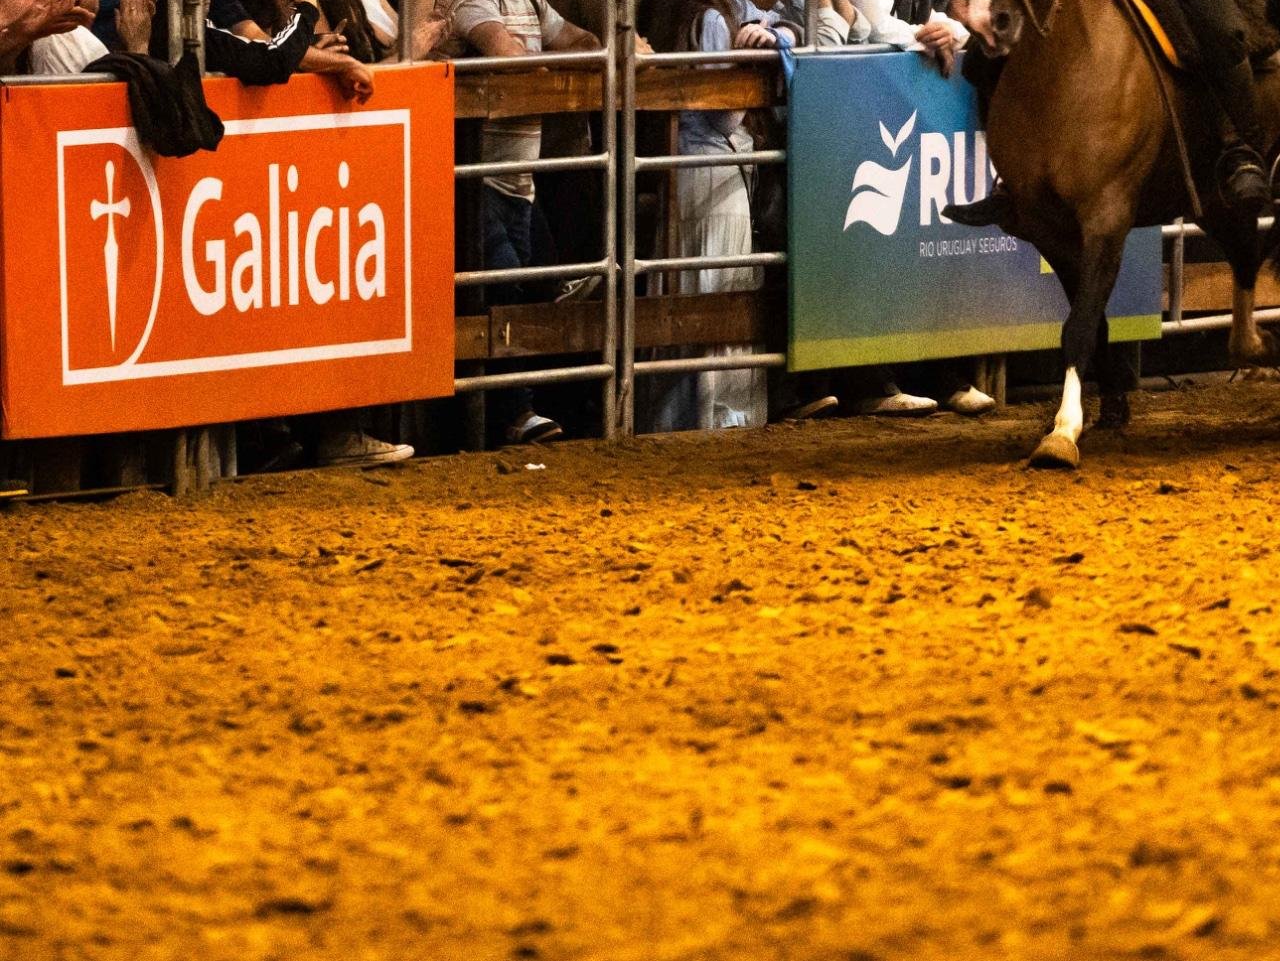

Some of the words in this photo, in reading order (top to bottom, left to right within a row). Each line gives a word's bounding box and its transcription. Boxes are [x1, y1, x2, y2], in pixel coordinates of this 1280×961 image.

[920, 130, 1004, 226] RU
[181, 160, 386, 316] Galicia
[919, 241, 935, 257] RIO
[936, 239, 977, 256] URUGUAY
[979, 236, 1018, 253] SEGUROS
